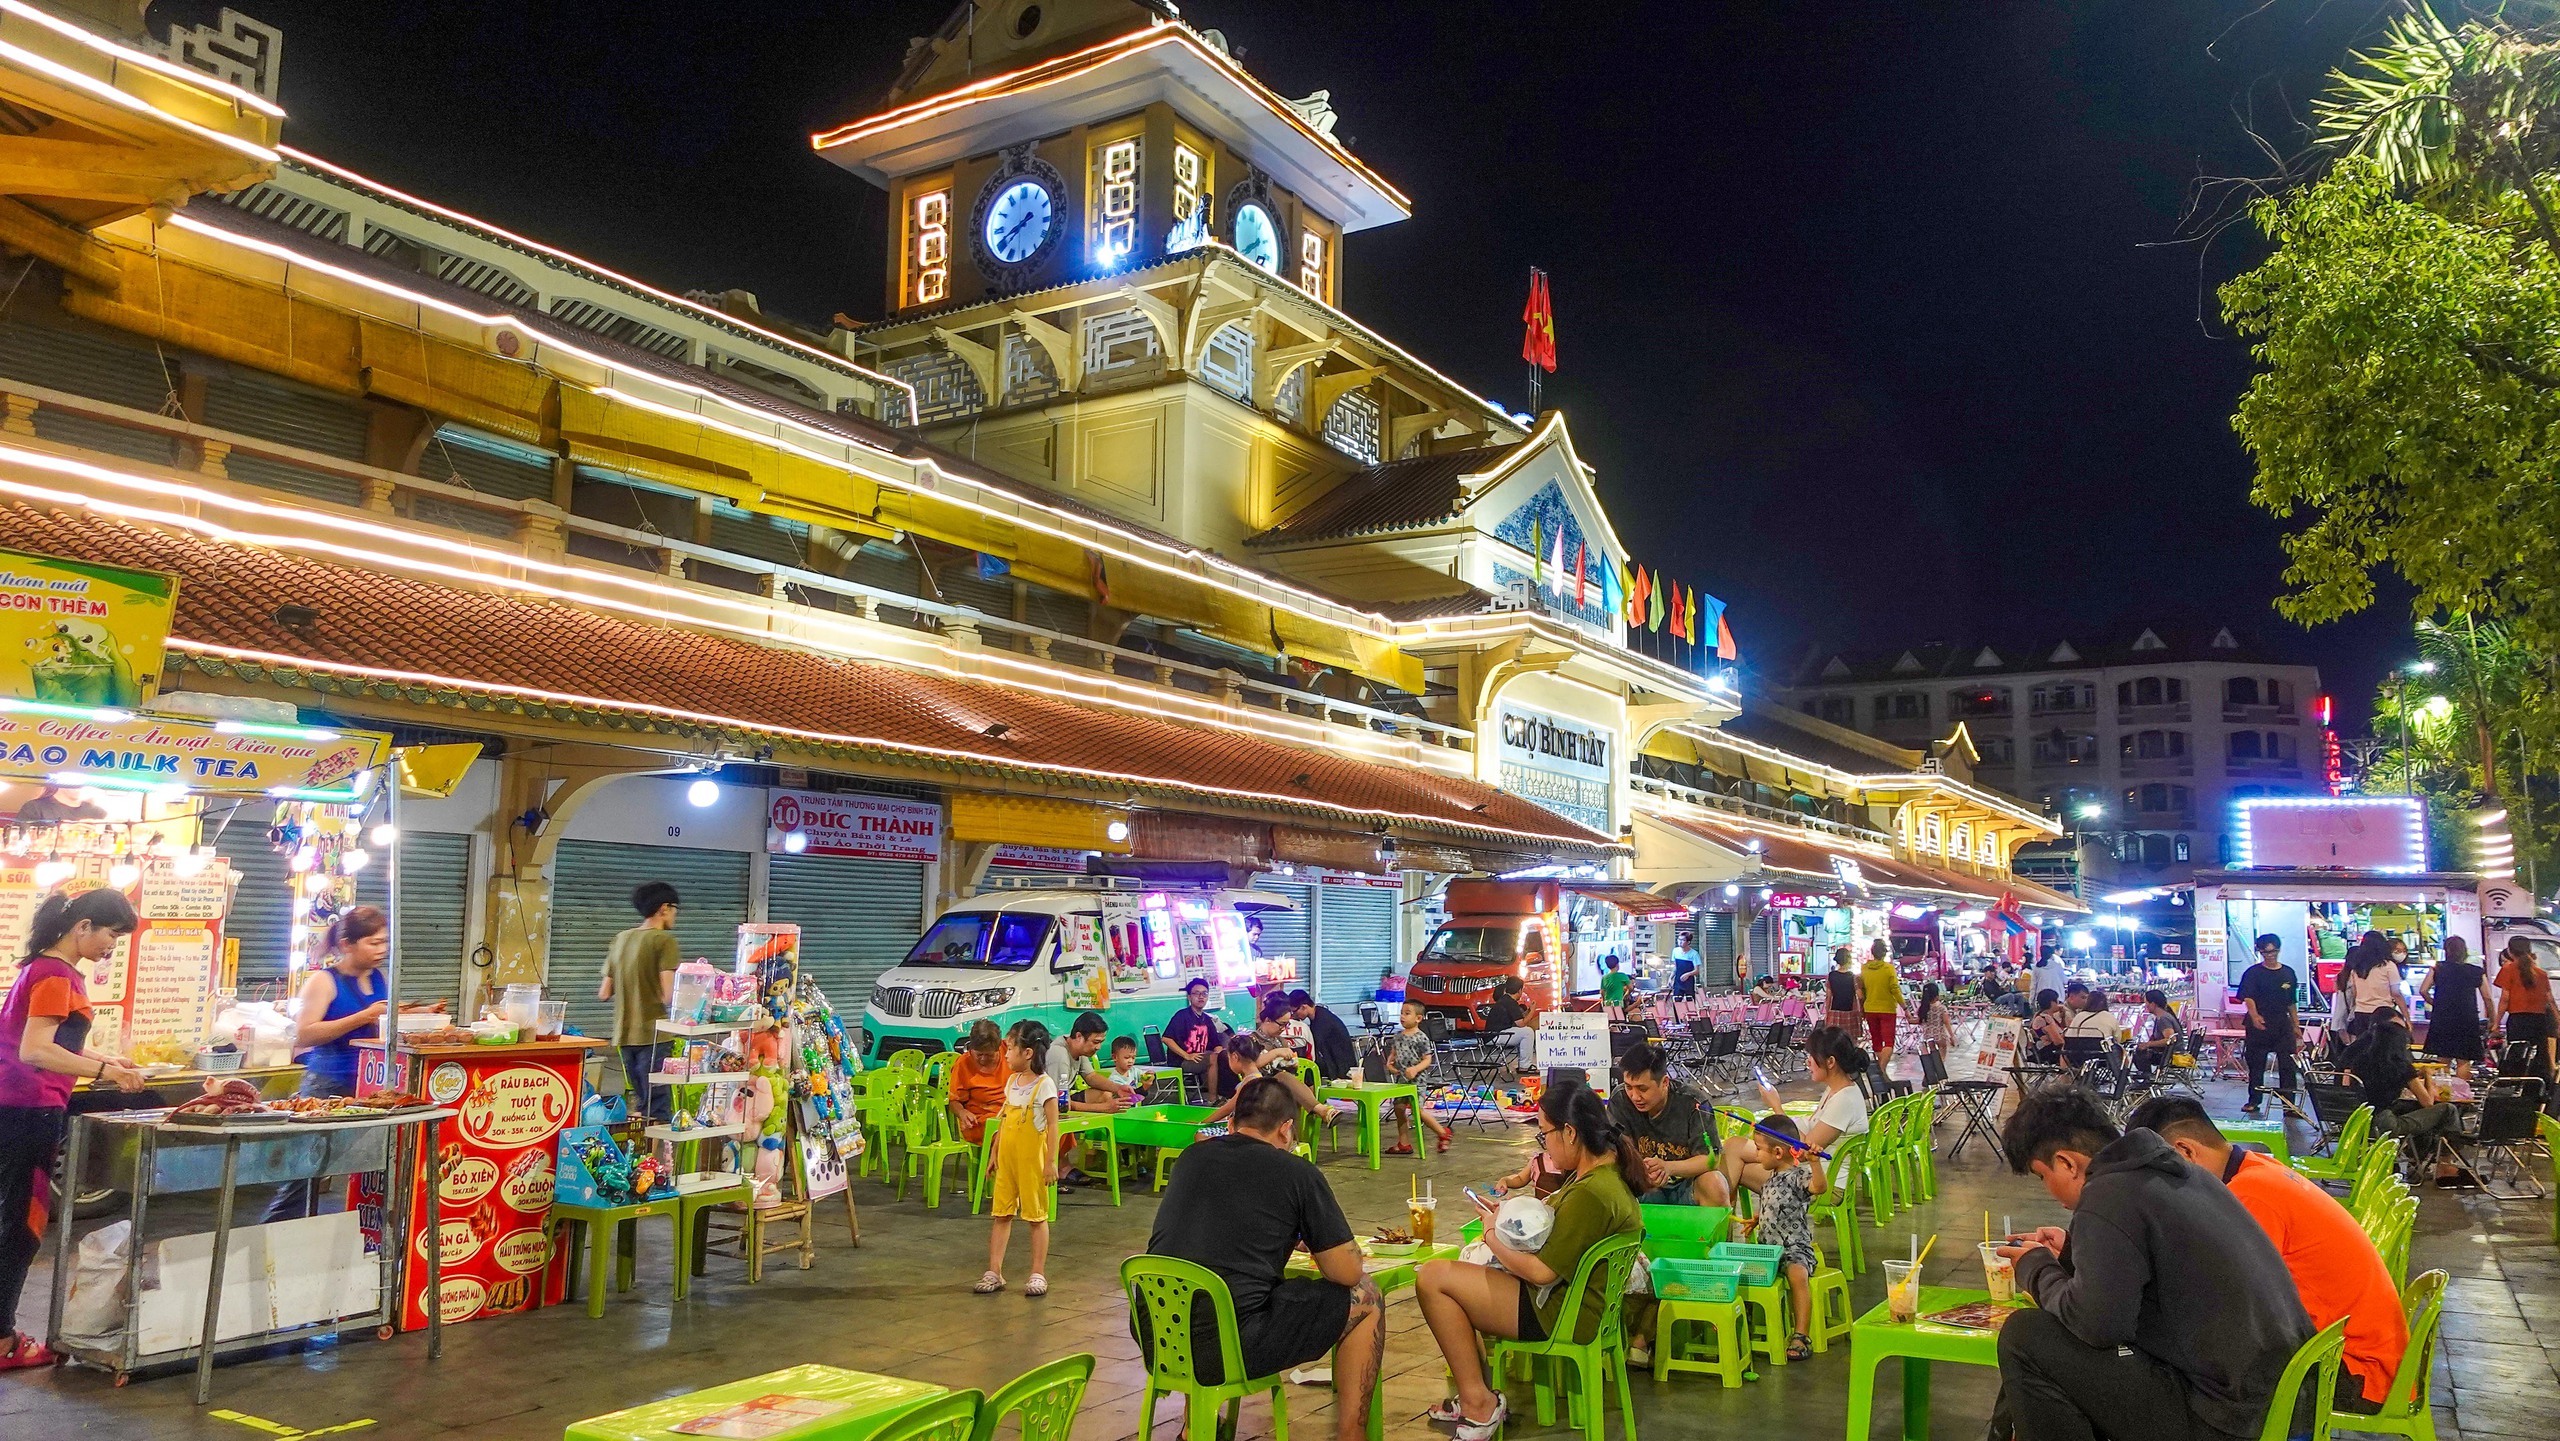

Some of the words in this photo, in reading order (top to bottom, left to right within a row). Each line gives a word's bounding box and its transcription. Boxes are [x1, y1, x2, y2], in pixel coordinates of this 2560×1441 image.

[0, 572, 44, 588] hơm
[50, 580, 88, 592] mát
[47, 596, 108, 617] THÈM
[38, 720, 111, 741] Coffee
[129, 726, 171, 745] Ăn
[175, 736, 212, 751] vặt
[226, 736, 278, 755] Xiên
[281, 747, 317, 759] que
[1502, 712, 1536, 759] CHỢ
[1538, 716, 1577, 761] BÌNH
[1577, 729, 1606, 768] TÂY
[81, 749, 180, 774] MILK
[194, 757, 259, 780] TEA
[800, 795, 826, 806] TRUNG
[828, 798, 843, 808] TÂM
[845, 800, 876, 812] THƯƠNG
[877, 803, 889, 813] MẠI
[891, 804, 906, 815] CHỢ
[924, 806, 939, 816] TÂY
[775, 806, 798, 825] 10
[803, 809, 852, 829] ĐỨC
[858, 815, 934, 836] THÀNH
[668, 826, 681, 837] 09
[804, 828, 848, 838] Chuyên
[851, 832, 872, 840] Bán
[834, 838, 852, 847] Áo
[891, 844, 926, 854] Trang
[7, 872, 31, 883] SỮA
[67, 882, 87, 892] GẠO
[1540, 1032, 1555, 1041] Khu
[1573, 1046, 1587, 1056] Phí
[365, 1050, 377, 1085] Ở
[501, 1076, 521, 1089] RÂU
[523, 1077, 550, 1090] BẠCH
[511, 1094, 537, 1110] TUỘT
[492, 1128, 506, 1136] 30K
[511, 1127, 524, 1135] 35K
[470, 1168, 495, 1183] XIÊN
[423, 1232, 453, 1249] CÂN
